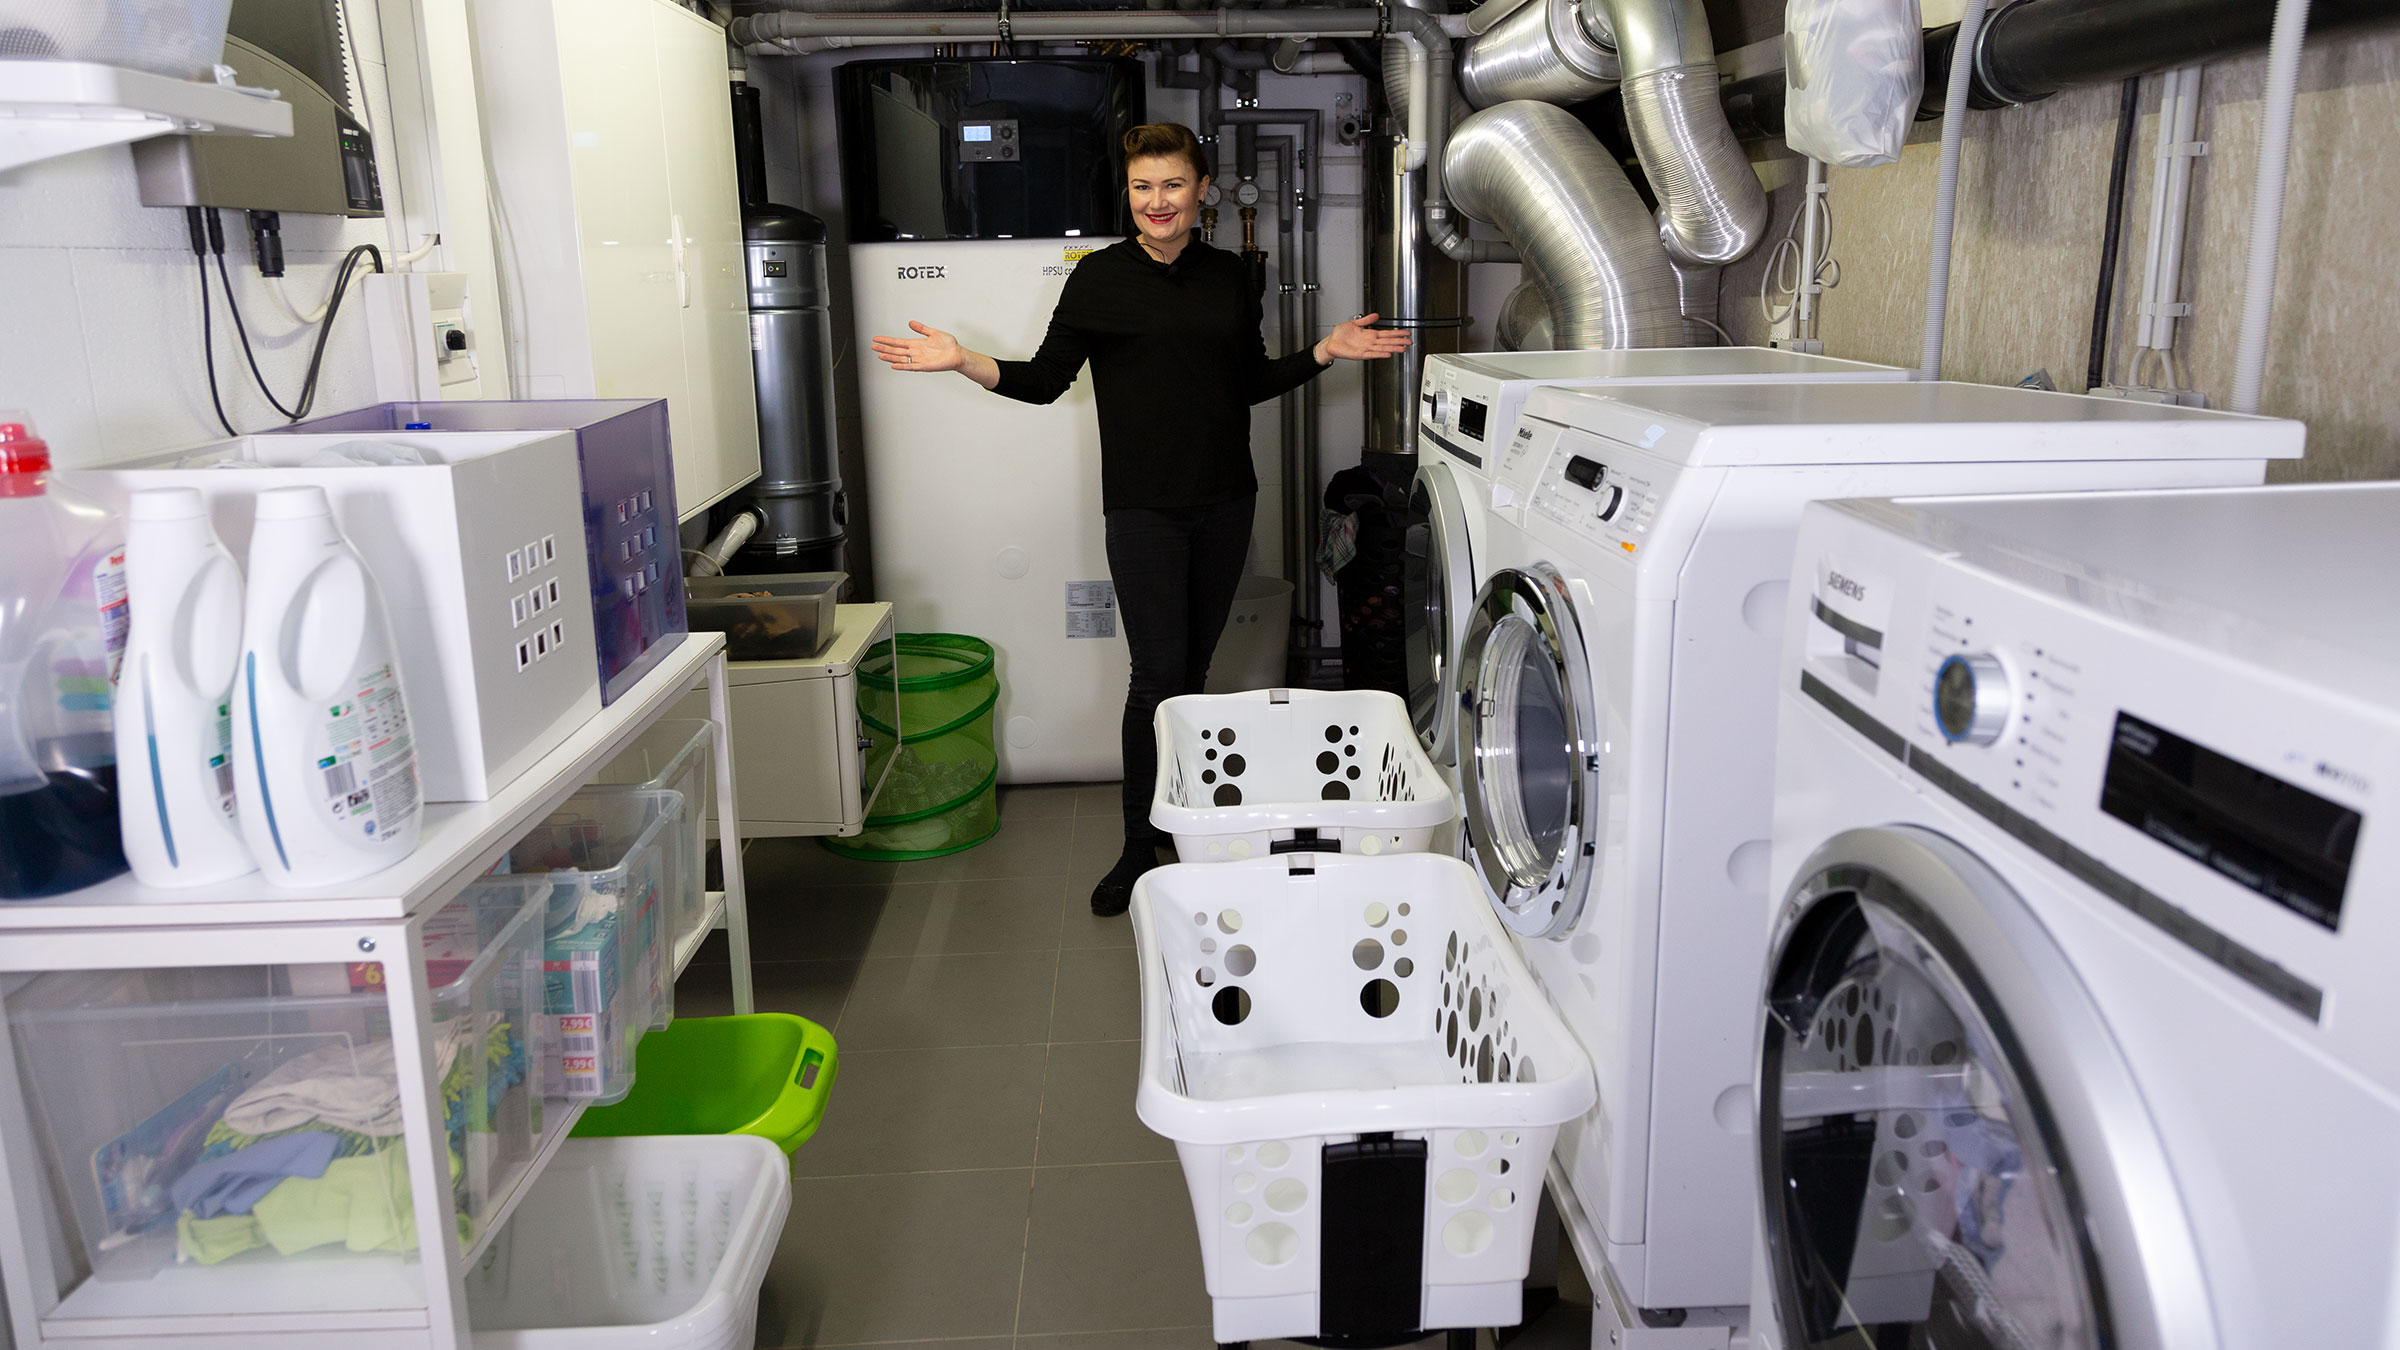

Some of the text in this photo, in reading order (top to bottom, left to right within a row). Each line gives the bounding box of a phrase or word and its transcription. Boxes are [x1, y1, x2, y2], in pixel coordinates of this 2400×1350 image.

[1065, 251, 1090, 259] ROTE
[898, 266, 945, 279] ROTEX
[1043, 266, 1063, 275] HPSU
[1828, 571, 1865, 601] SIEMENS
